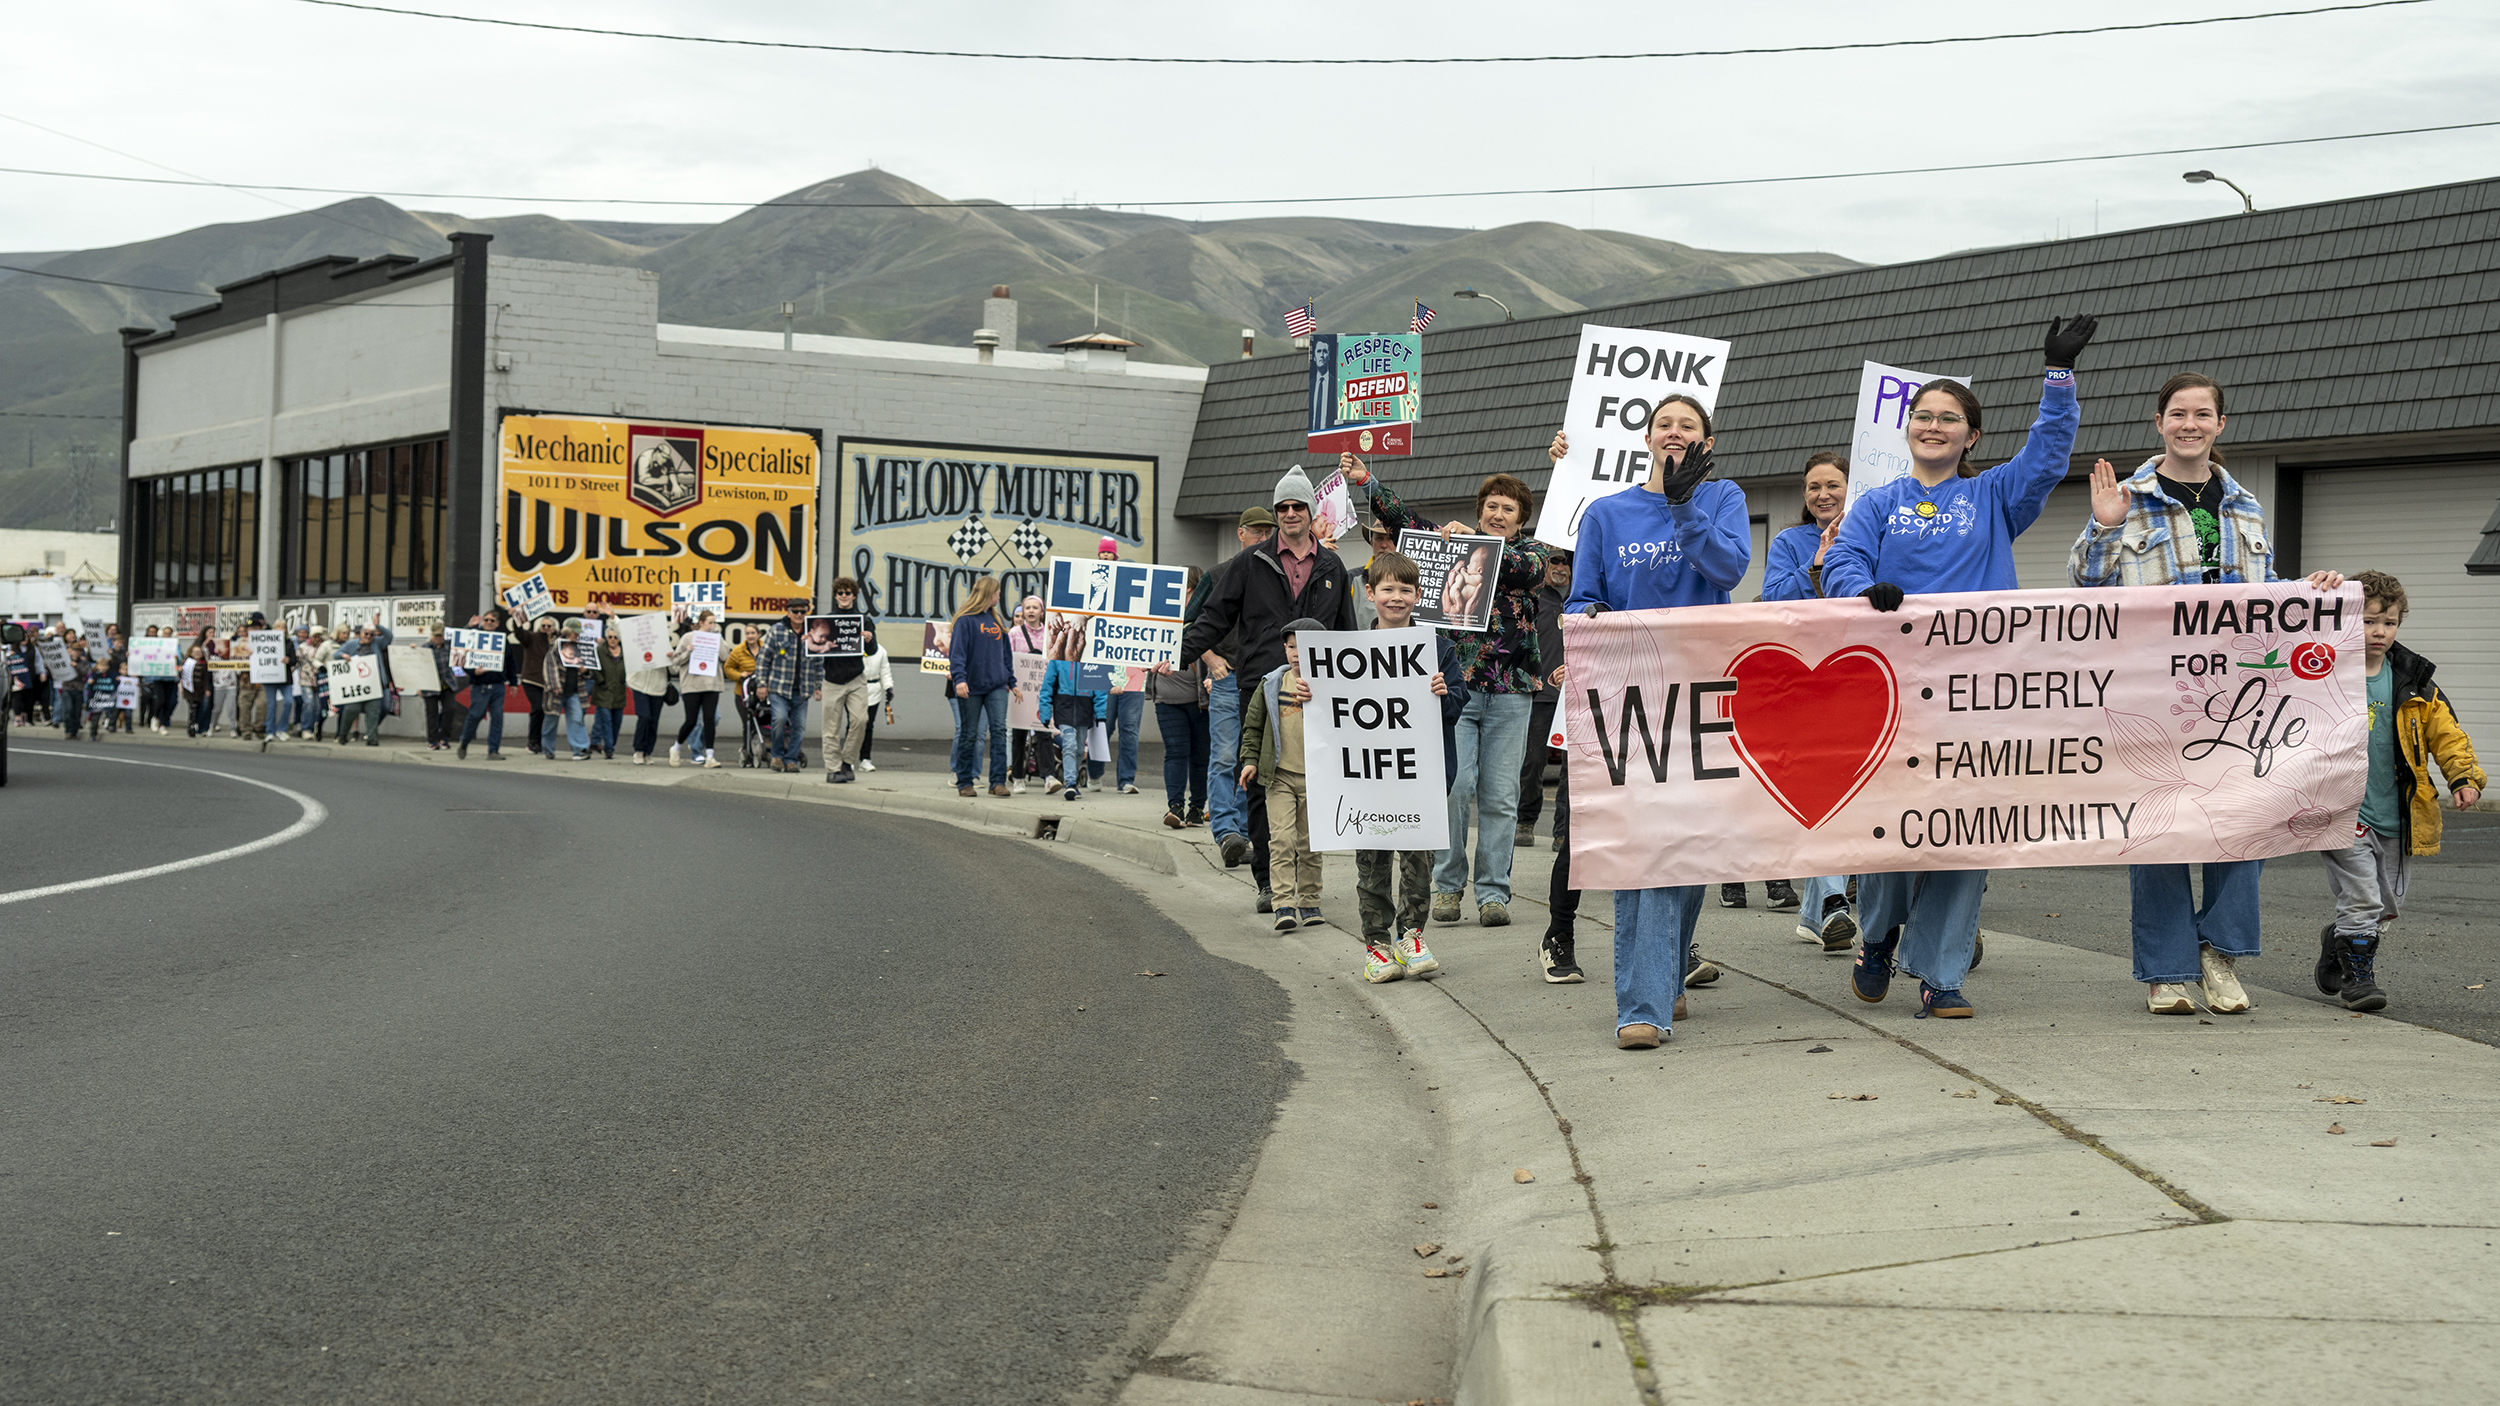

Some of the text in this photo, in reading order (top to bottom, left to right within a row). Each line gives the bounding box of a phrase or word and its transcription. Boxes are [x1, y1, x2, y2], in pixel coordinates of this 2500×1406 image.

[1344, 338, 1413, 366] RESPECT
[1362, 358, 1392, 373] LIFE
[1586, 343, 1716, 387] HONK
[1348, 376, 1406, 398] DEFEND
[1362, 402, 1391, 416] LIFE
[1596, 396, 1654, 431] FO
[514, 433, 626, 466] Mechanic
[704, 444, 812, 476] Specialist
[1858, 430, 1910, 480] Caring
[1591, 448, 1654, 484] LIF
[528, 476, 620, 492] 1011 D Street
[707, 486, 788, 502] Lewiston, ID
[1324, 474, 1342, 496] LIFE!
[853, 456, 1143, 543] MELODY MUFFLER
[506, 488, 807, 587] WILSON
[1891, 525, 1916, 535] in
[1404, 548, 1458, 564] SMALLEST
[1405, 538, 1469, 555] EVEN THE
[1622, 545, 1683, 570] in love
[585, 564, 680, 585] AutoTech
[1434, 562, 1450, 571] CAN
[506, 576, 546, 608] LIFE
[674, 584, 723, 602] LIFE
[854, 548, 881, 618] &
[1052, 560, 1184, 618] LIFE
[1421, 587, 1441, 599] HE
[398, 601, 436, 612] IMPORTS
[588, 591, 664, 608] DOMESTIC
[1925, 603, 2120, 647] ADOPTION
[2172, 596, 2344, 636] MARCH
[251, 634, 281, 642] HONK
[454, 630, 503, 651] LIFE
[1094, 618, 1156, 644] RESPECT
[258, 658, 278, 666] LIFE
[925, 649, 944, 658] Me.
[1020, 659, 1030, 668] YOU
[1092, 638, 1155, 664] PROTECT
[1308, 643, 1428, 680] HONK
[141, 663, 170, 674] LIFE
[332, 662, 351, 676] PRO
[1083, 663, 1099, 672] hope
[2170, 652, 2228, 678] FOR
[341, 685, 371, 698] Life
[1948, 670, 2114, 712] ELDERLY
[1332, 697, 1412, 730] FOR
[1586, 680, 1740, 787] WE
[2182, 676, 2310, 778] Life
[1342, 747, 1417, 780] LIFE
[1935, 736, 2104, 780] FAMILIES
[1900, 802, 2136, 849] COMMUNITY
